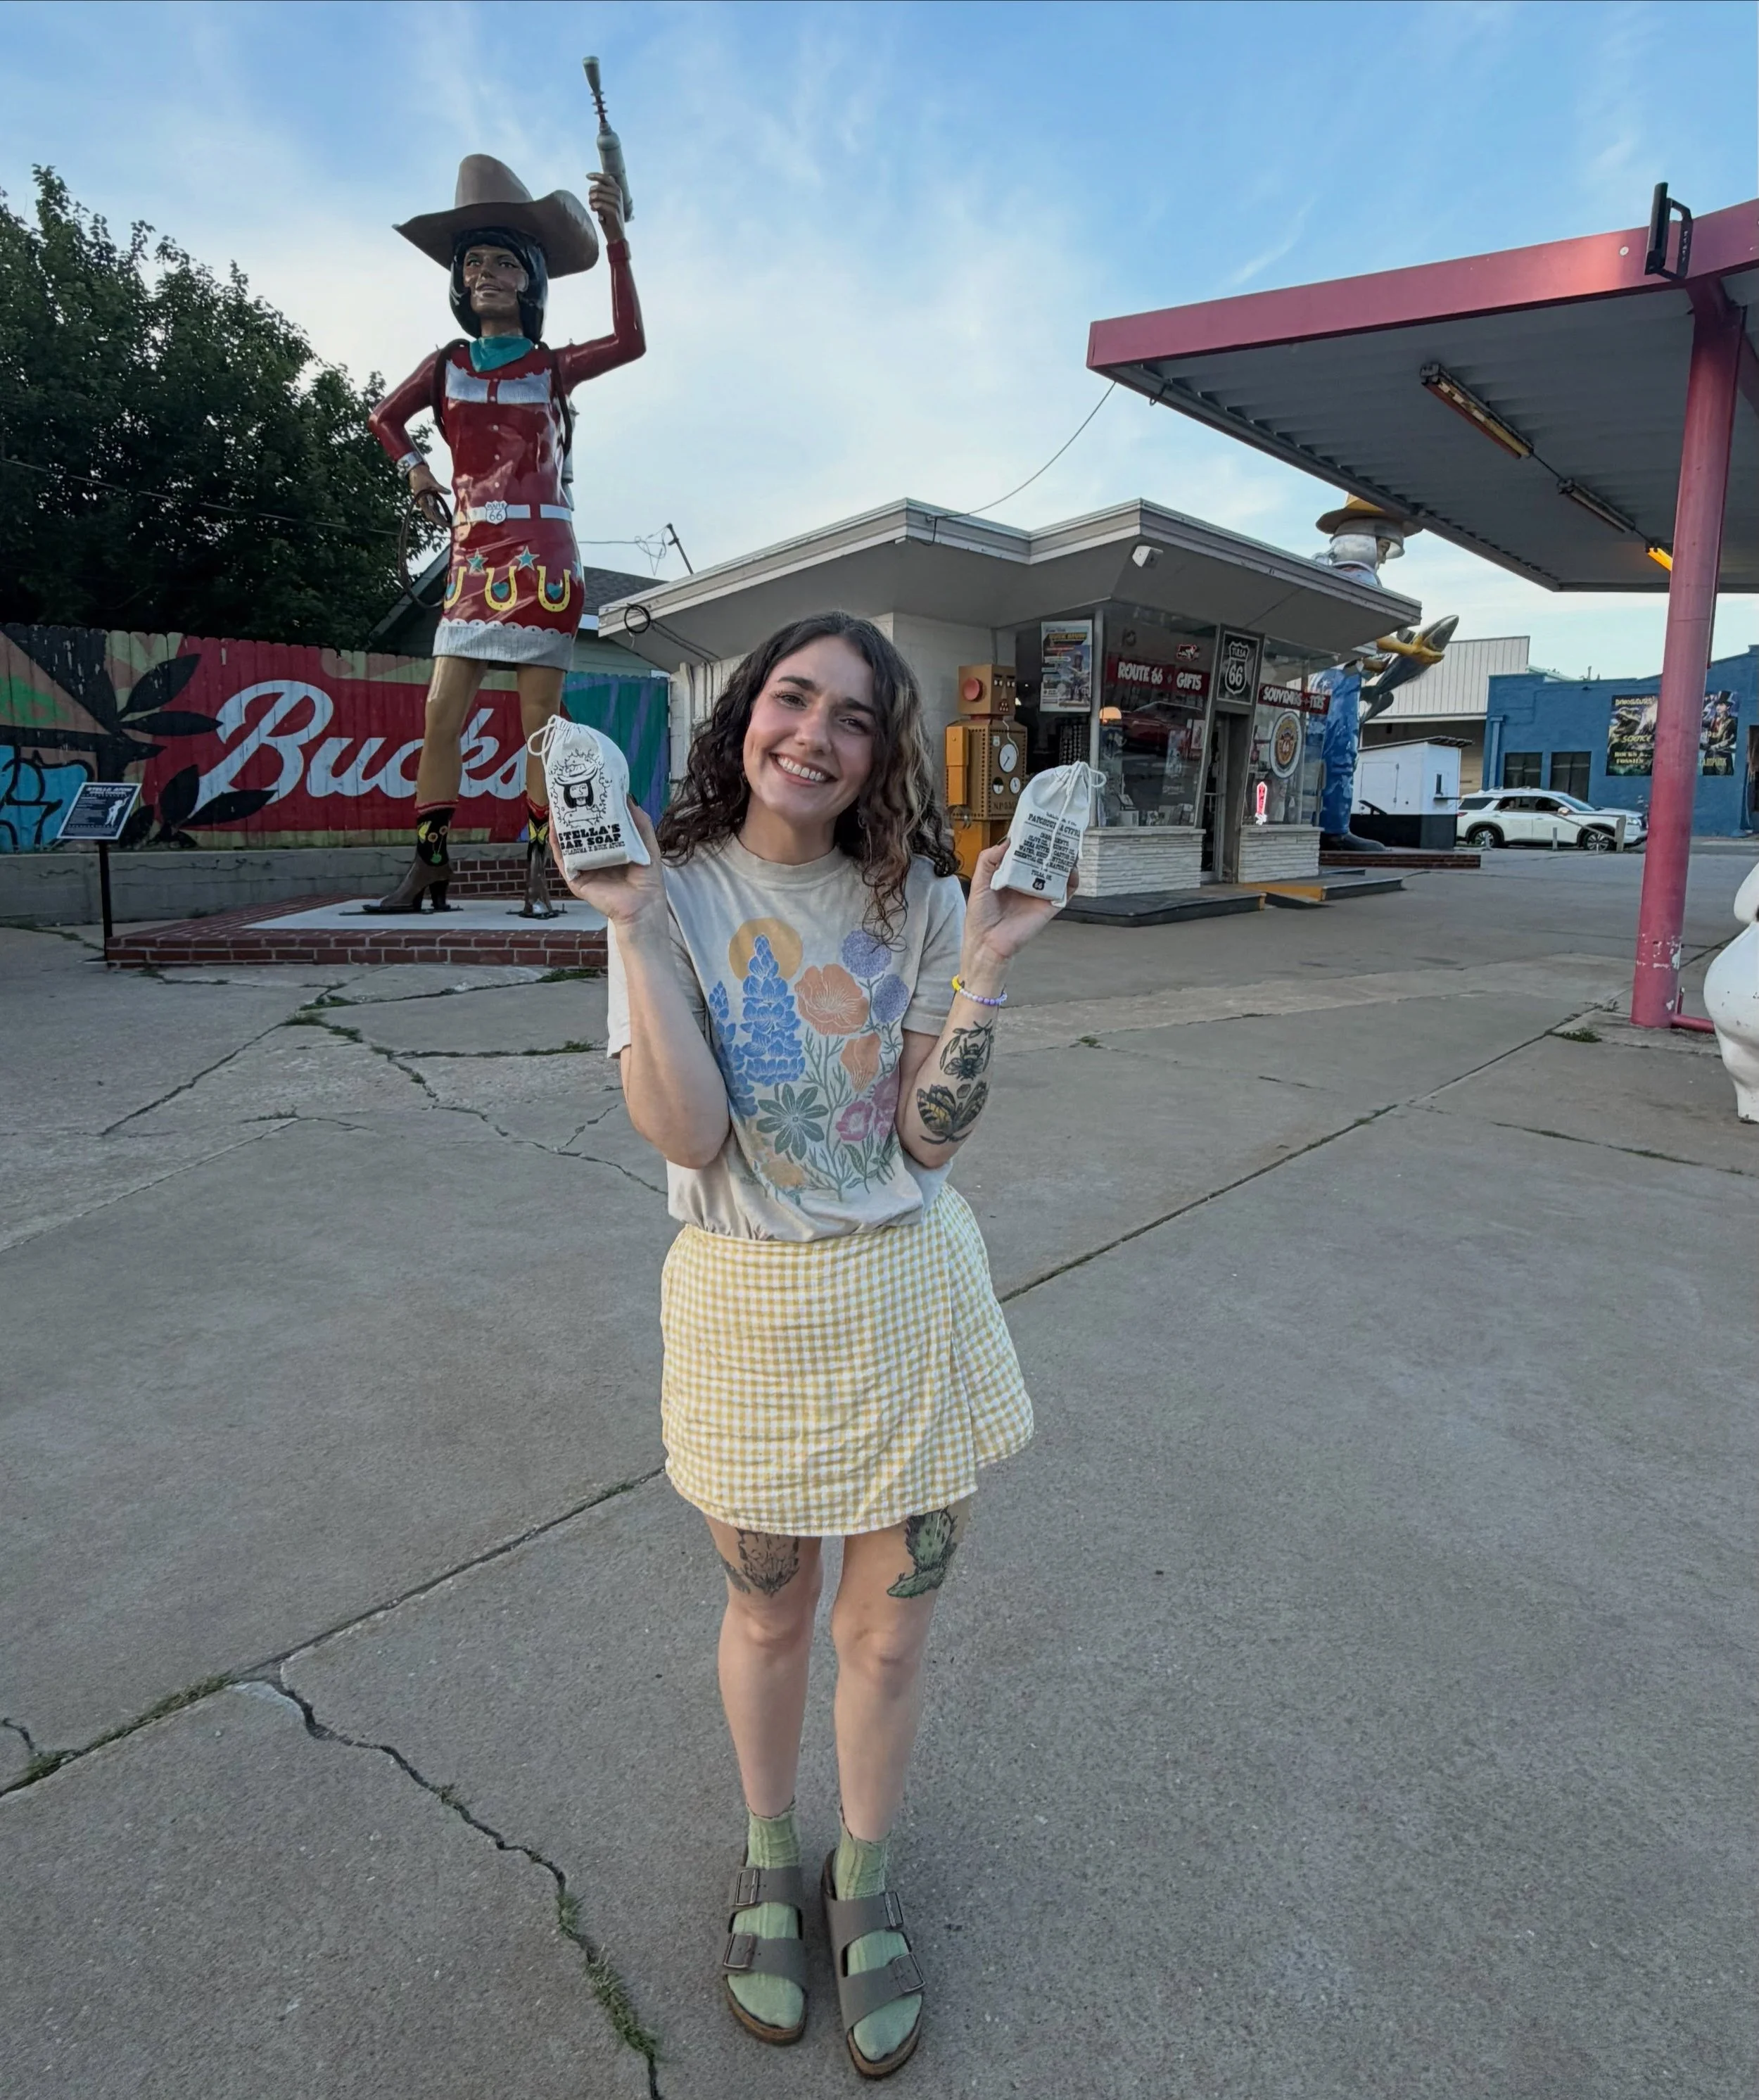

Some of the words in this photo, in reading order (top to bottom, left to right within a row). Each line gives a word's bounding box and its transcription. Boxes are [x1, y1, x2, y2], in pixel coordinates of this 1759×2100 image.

[489, 510, 503, 521] 66
[1231, 646, 1246, 657] TULSA
[1117, 662, 1150, 682] ROUTE
[1151, 666, 1163, 685] 66
[1176, 671, 1202, 690] GIFTS
[1228, 664, 1243, 687] 66
[587, 833, 621, 846] SOAP
